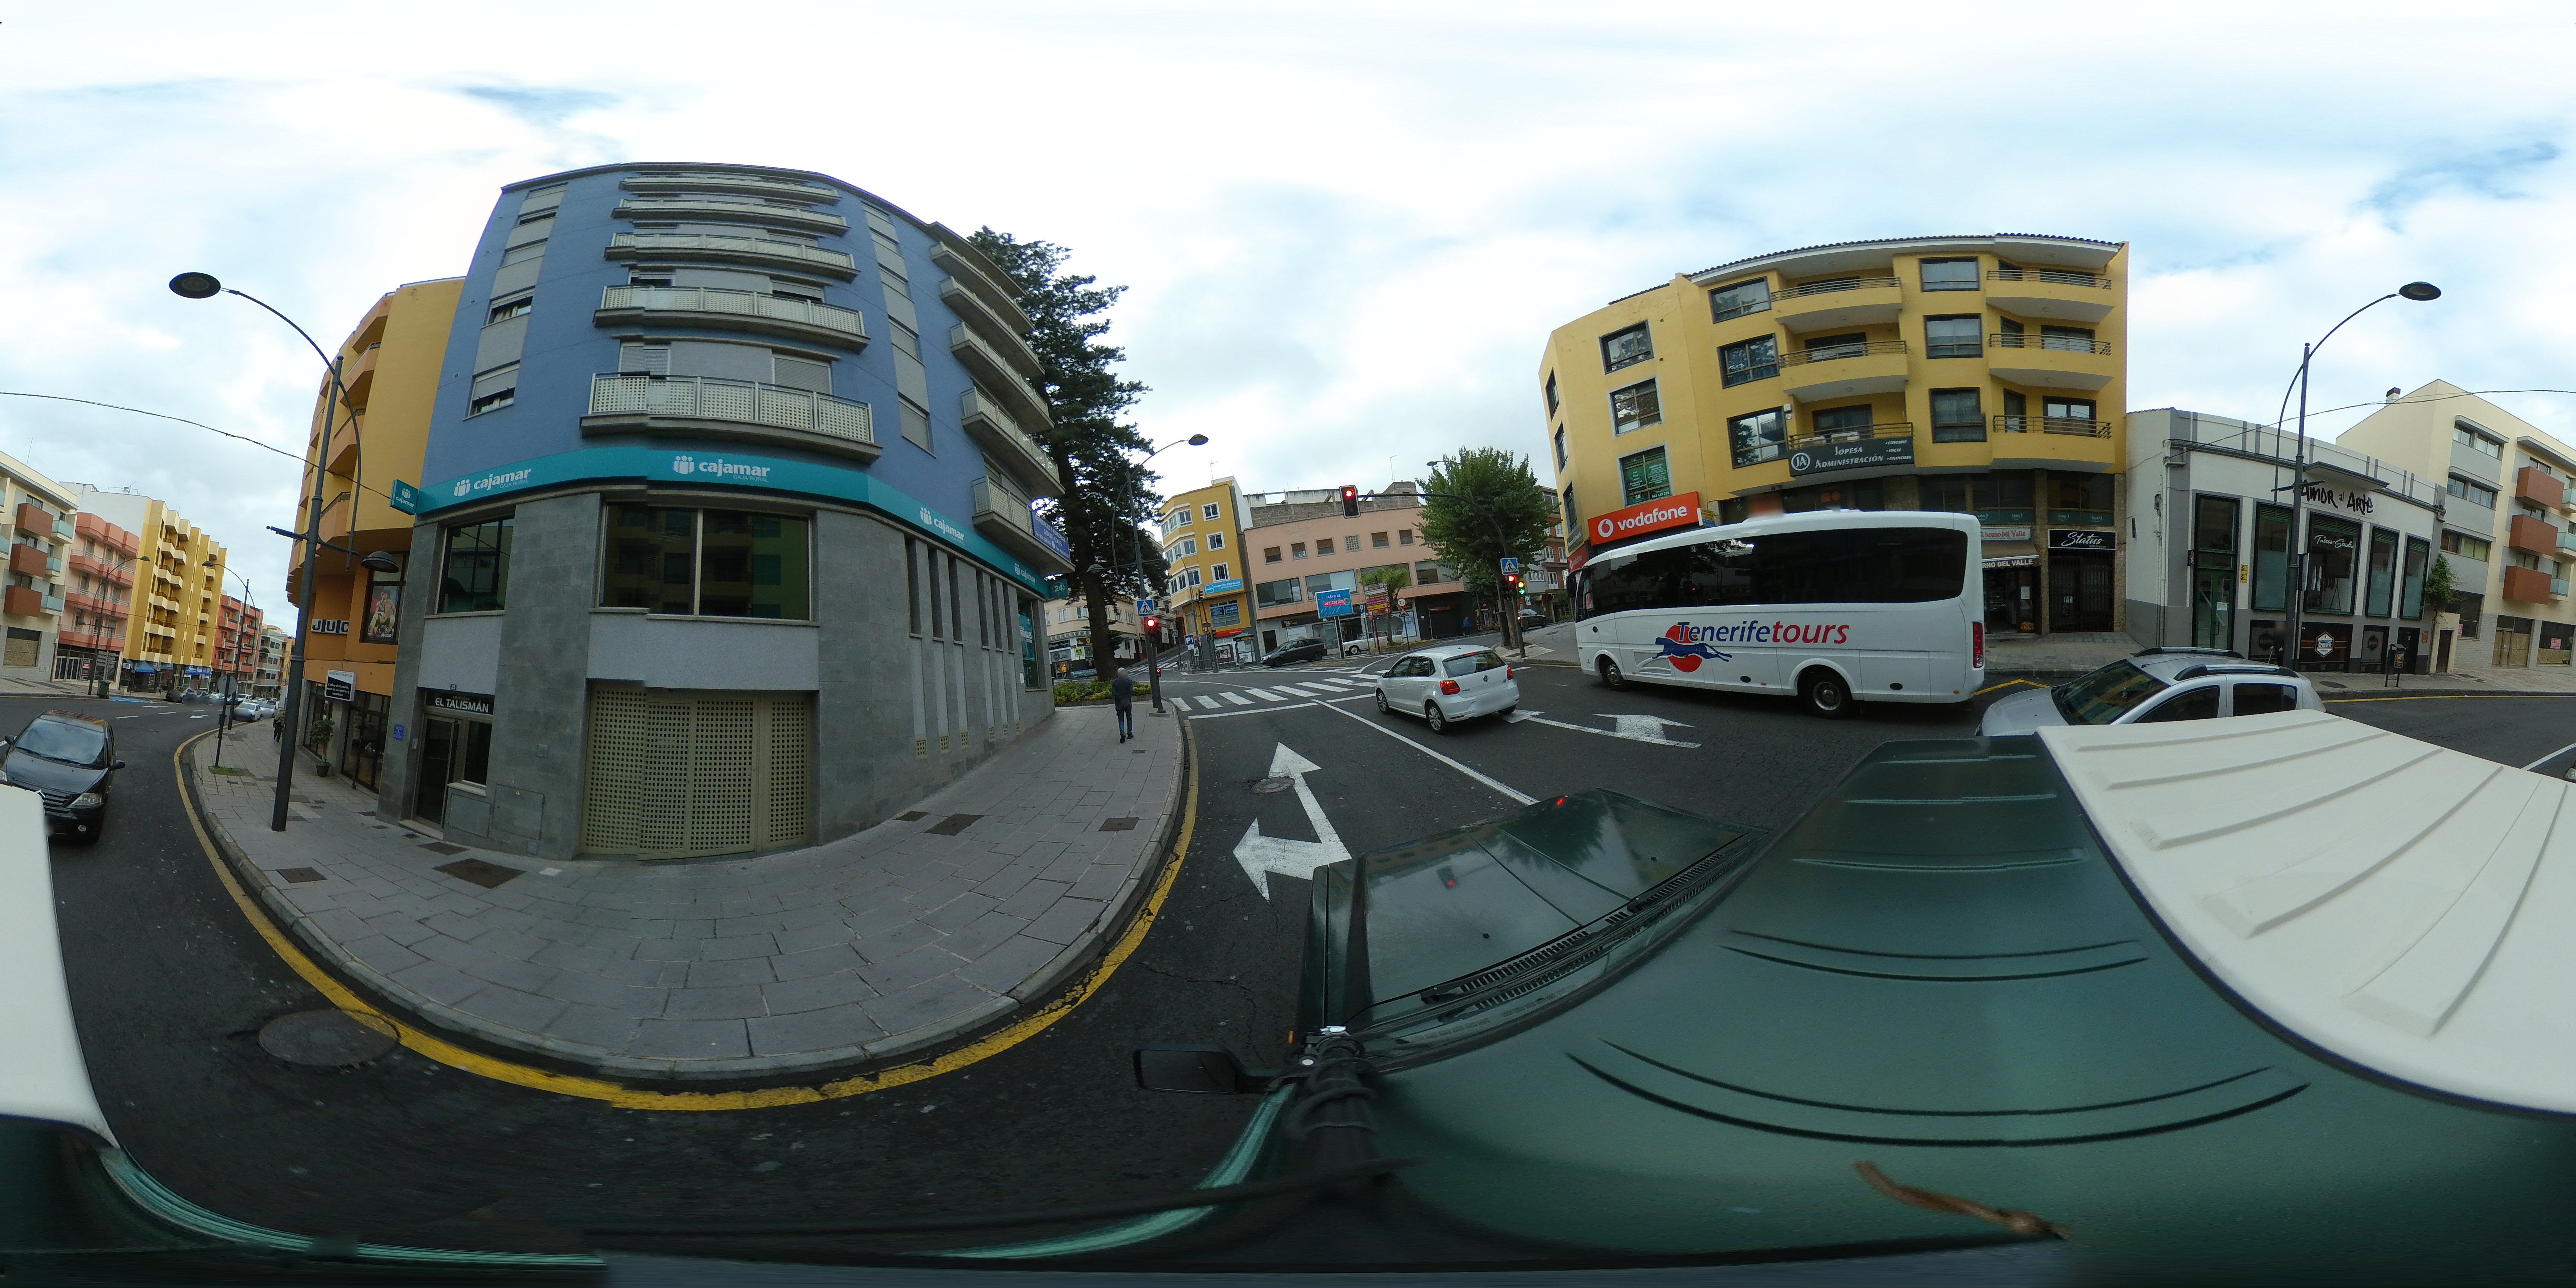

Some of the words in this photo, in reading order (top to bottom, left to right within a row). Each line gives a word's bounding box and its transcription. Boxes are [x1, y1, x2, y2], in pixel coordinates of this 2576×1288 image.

[1834, 446, 1863, 456] JOPESA
[699, 459, 770, 477] cajamar
[1815, 454, 1884, 469] ADMINISTRACIÓN
[474, 468, 532, 490] cajamar
[396, 495, 415, 508] cajamar
[1617, 506, 1687, 531] vodafone
[934, 518, 965, 541] cajamar
[2061, 531, 2104, 546] Status
[2314, 535, 2335, 544] Tattoo
[2334, 539, 2354, 548] Studio
[1021, 569, 1036, 584] cajamar
[435, 697, 444, 707] EL
[446, 698, 489, 713] TALISMÁN
